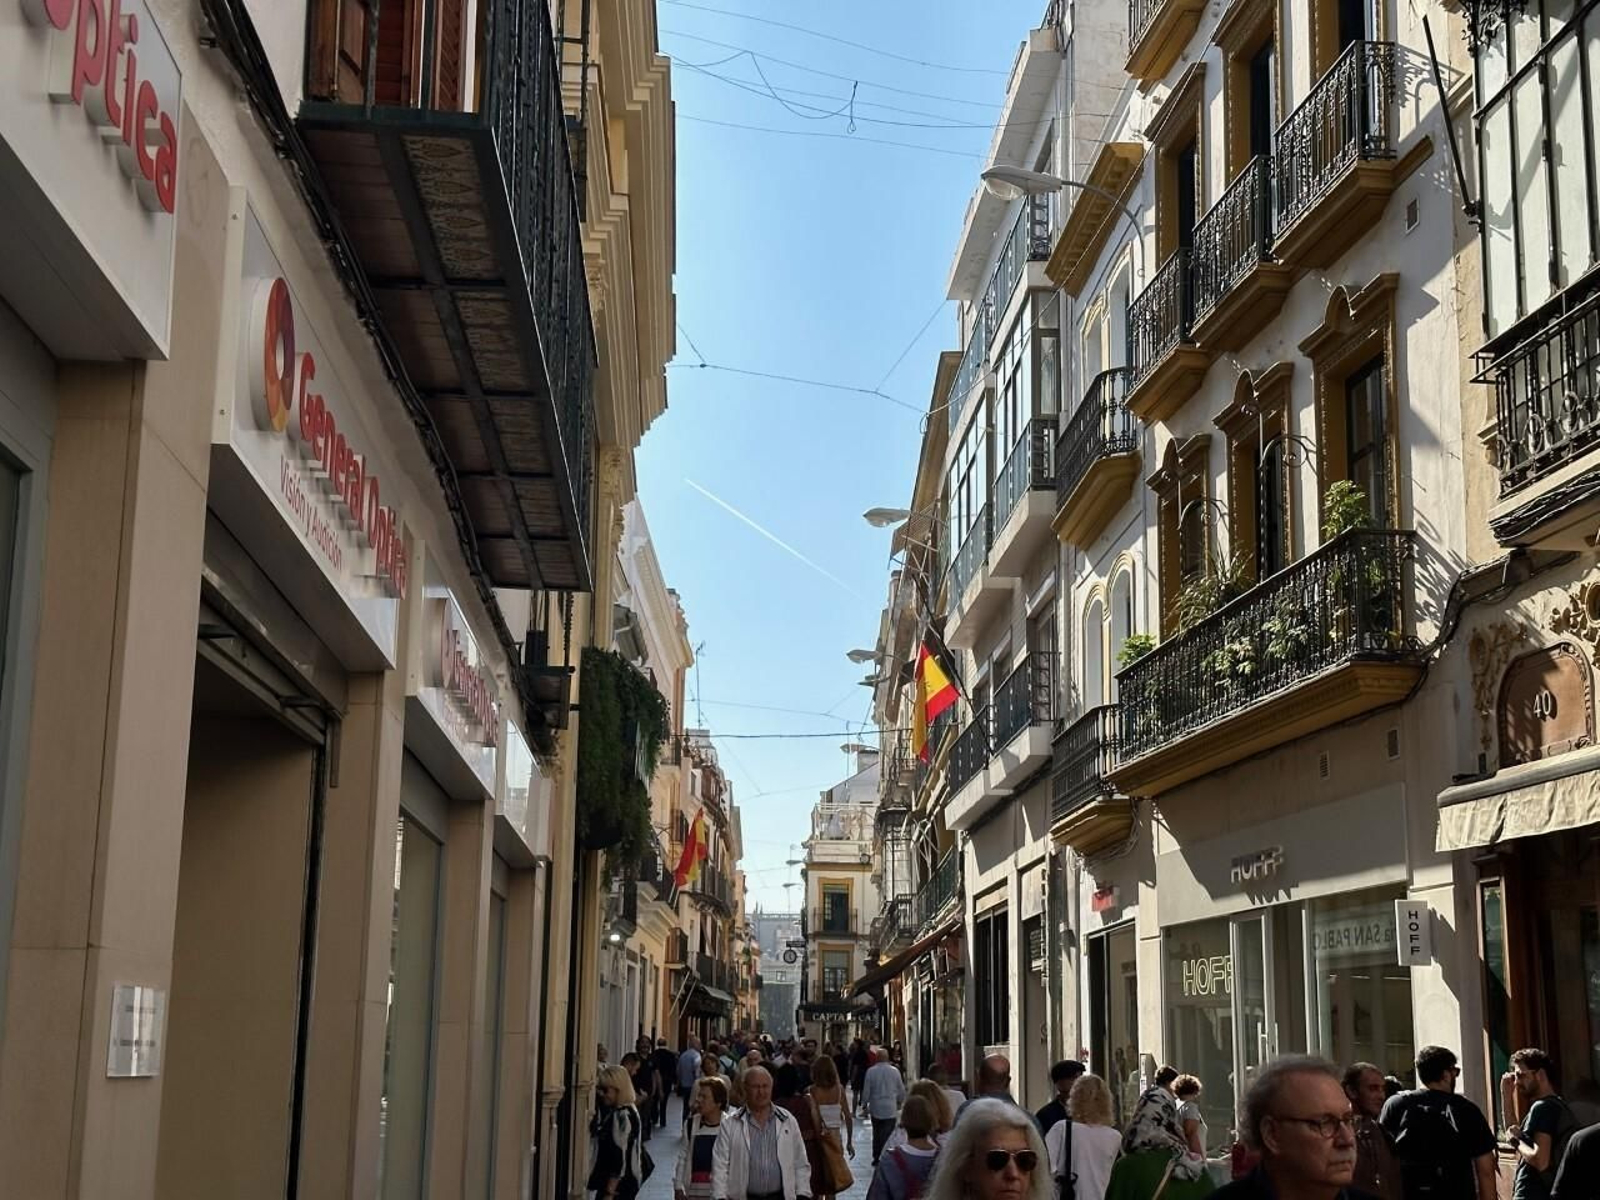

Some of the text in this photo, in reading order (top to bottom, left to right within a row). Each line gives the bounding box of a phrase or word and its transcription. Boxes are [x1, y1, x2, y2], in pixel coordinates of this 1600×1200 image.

[300, 352, 365, 532] General
[280, 453, 306, 523] Visión
[305, 501, 312, 538] y
[1533, 690, 1551, 718] 40
[1408, 910, 1421, 955] HOFF
